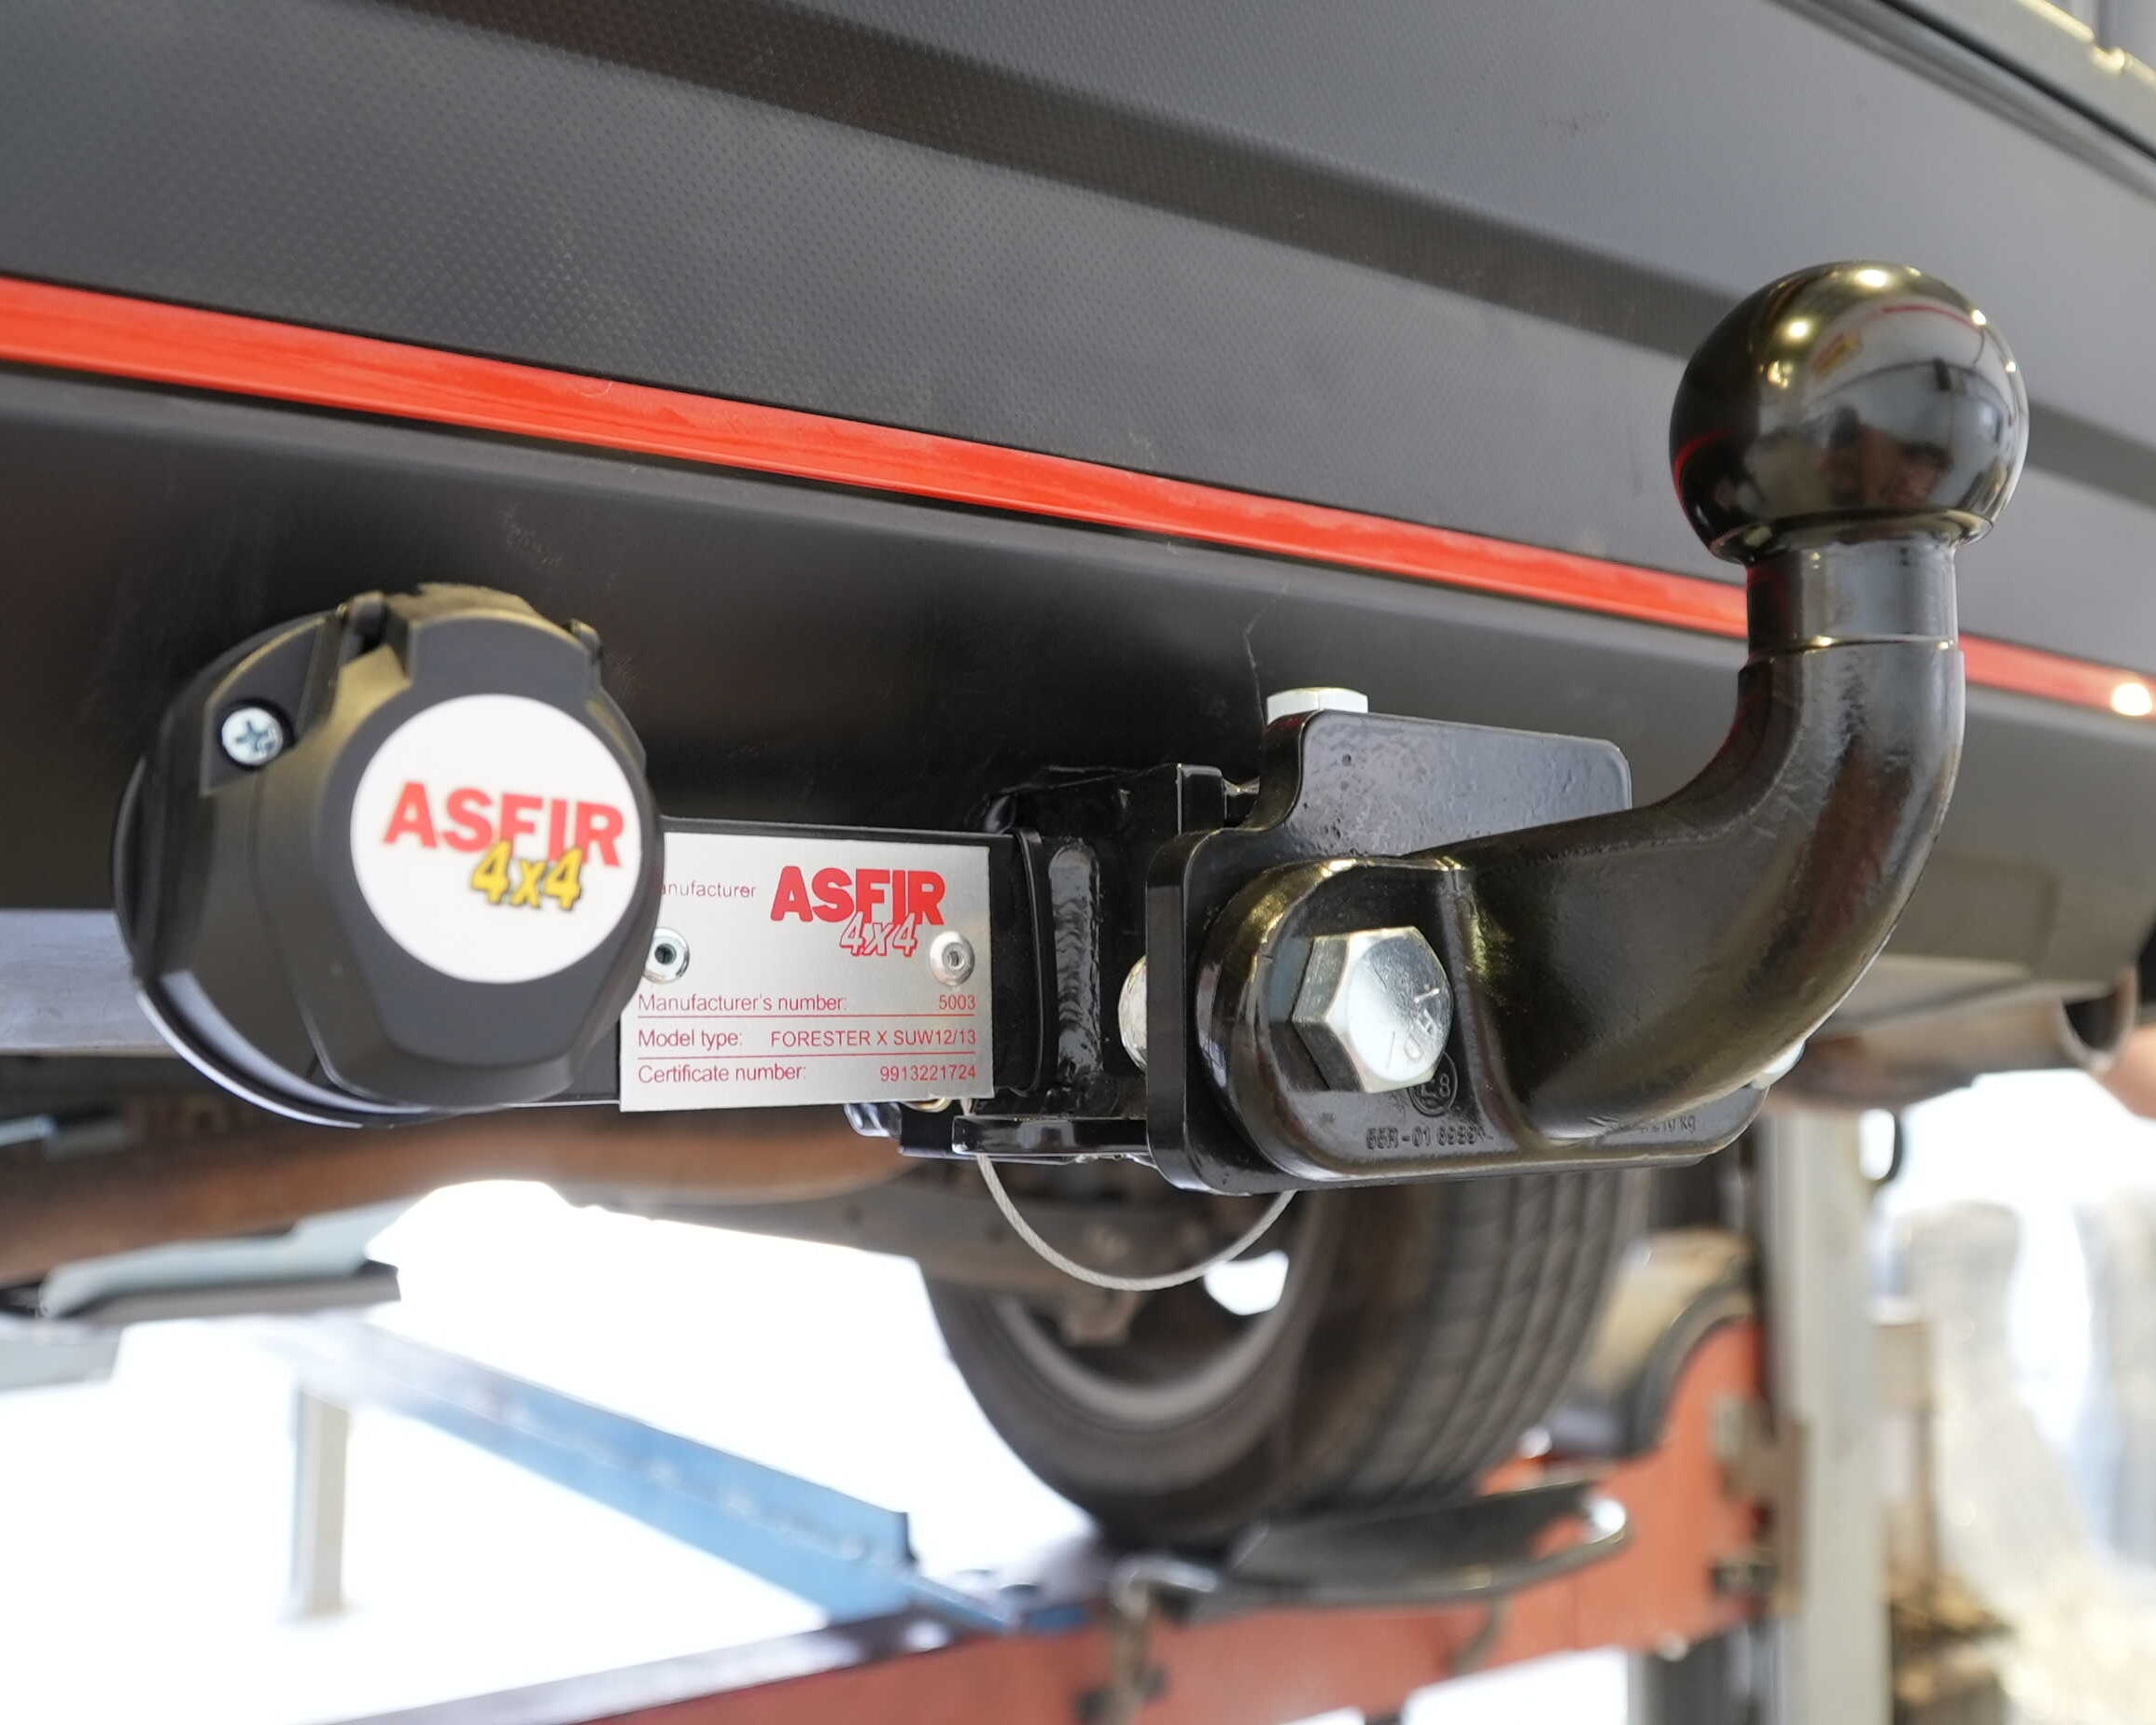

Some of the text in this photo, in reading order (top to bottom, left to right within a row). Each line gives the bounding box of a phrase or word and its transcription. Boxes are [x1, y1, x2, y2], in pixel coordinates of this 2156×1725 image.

[384, 780, 624, 867] ASFIR
[470, 839, 583, 912] 4x4
[660, 880, 757, 898] anufacturer
[770, 865, 945, 925] ASFIR
[638, 993, 976, 1011] Manufacturer's number: 5003
[638, 1030, 976, 1051] Model type: FORESTER X SUW12/13
[638, 1062, 977, 1084] Certificate number: 9913221724
